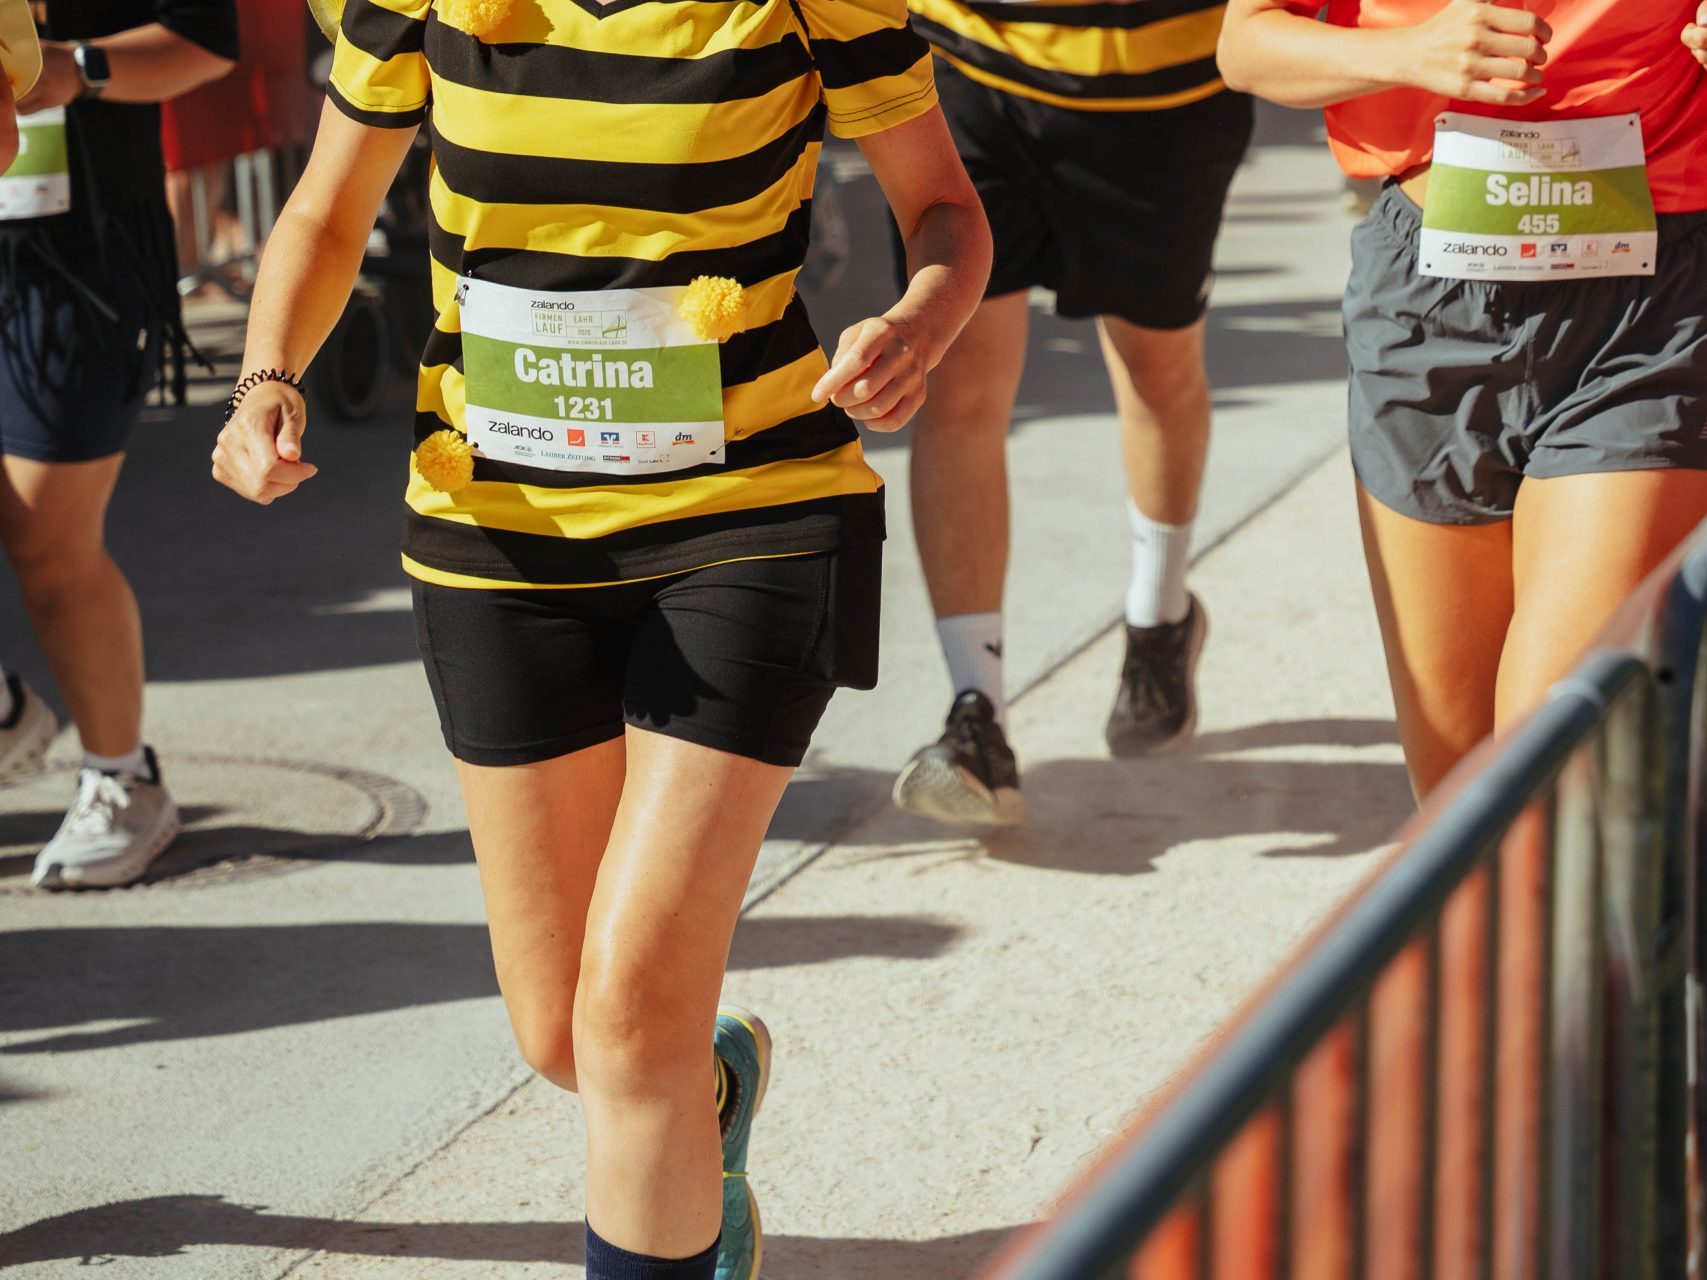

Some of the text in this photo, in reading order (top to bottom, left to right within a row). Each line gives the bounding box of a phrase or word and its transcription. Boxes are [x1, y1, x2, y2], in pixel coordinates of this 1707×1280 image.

[1485, 173, 1593, 206] Selina
[1517, 214, 1560, 234] 455
[1443, 242, 1507, 257] zalando
[531, 300, 575, 311] zalando
[534, 312, 563, 322] FIRMEN
[535, 322, 563, 335] LAUF
[514, 347, 654, 389] Catrina
[553, 395, 613, 420] 1231
[488, 420, 554, 442] zalando
[674, 432, 693, 442] dm
